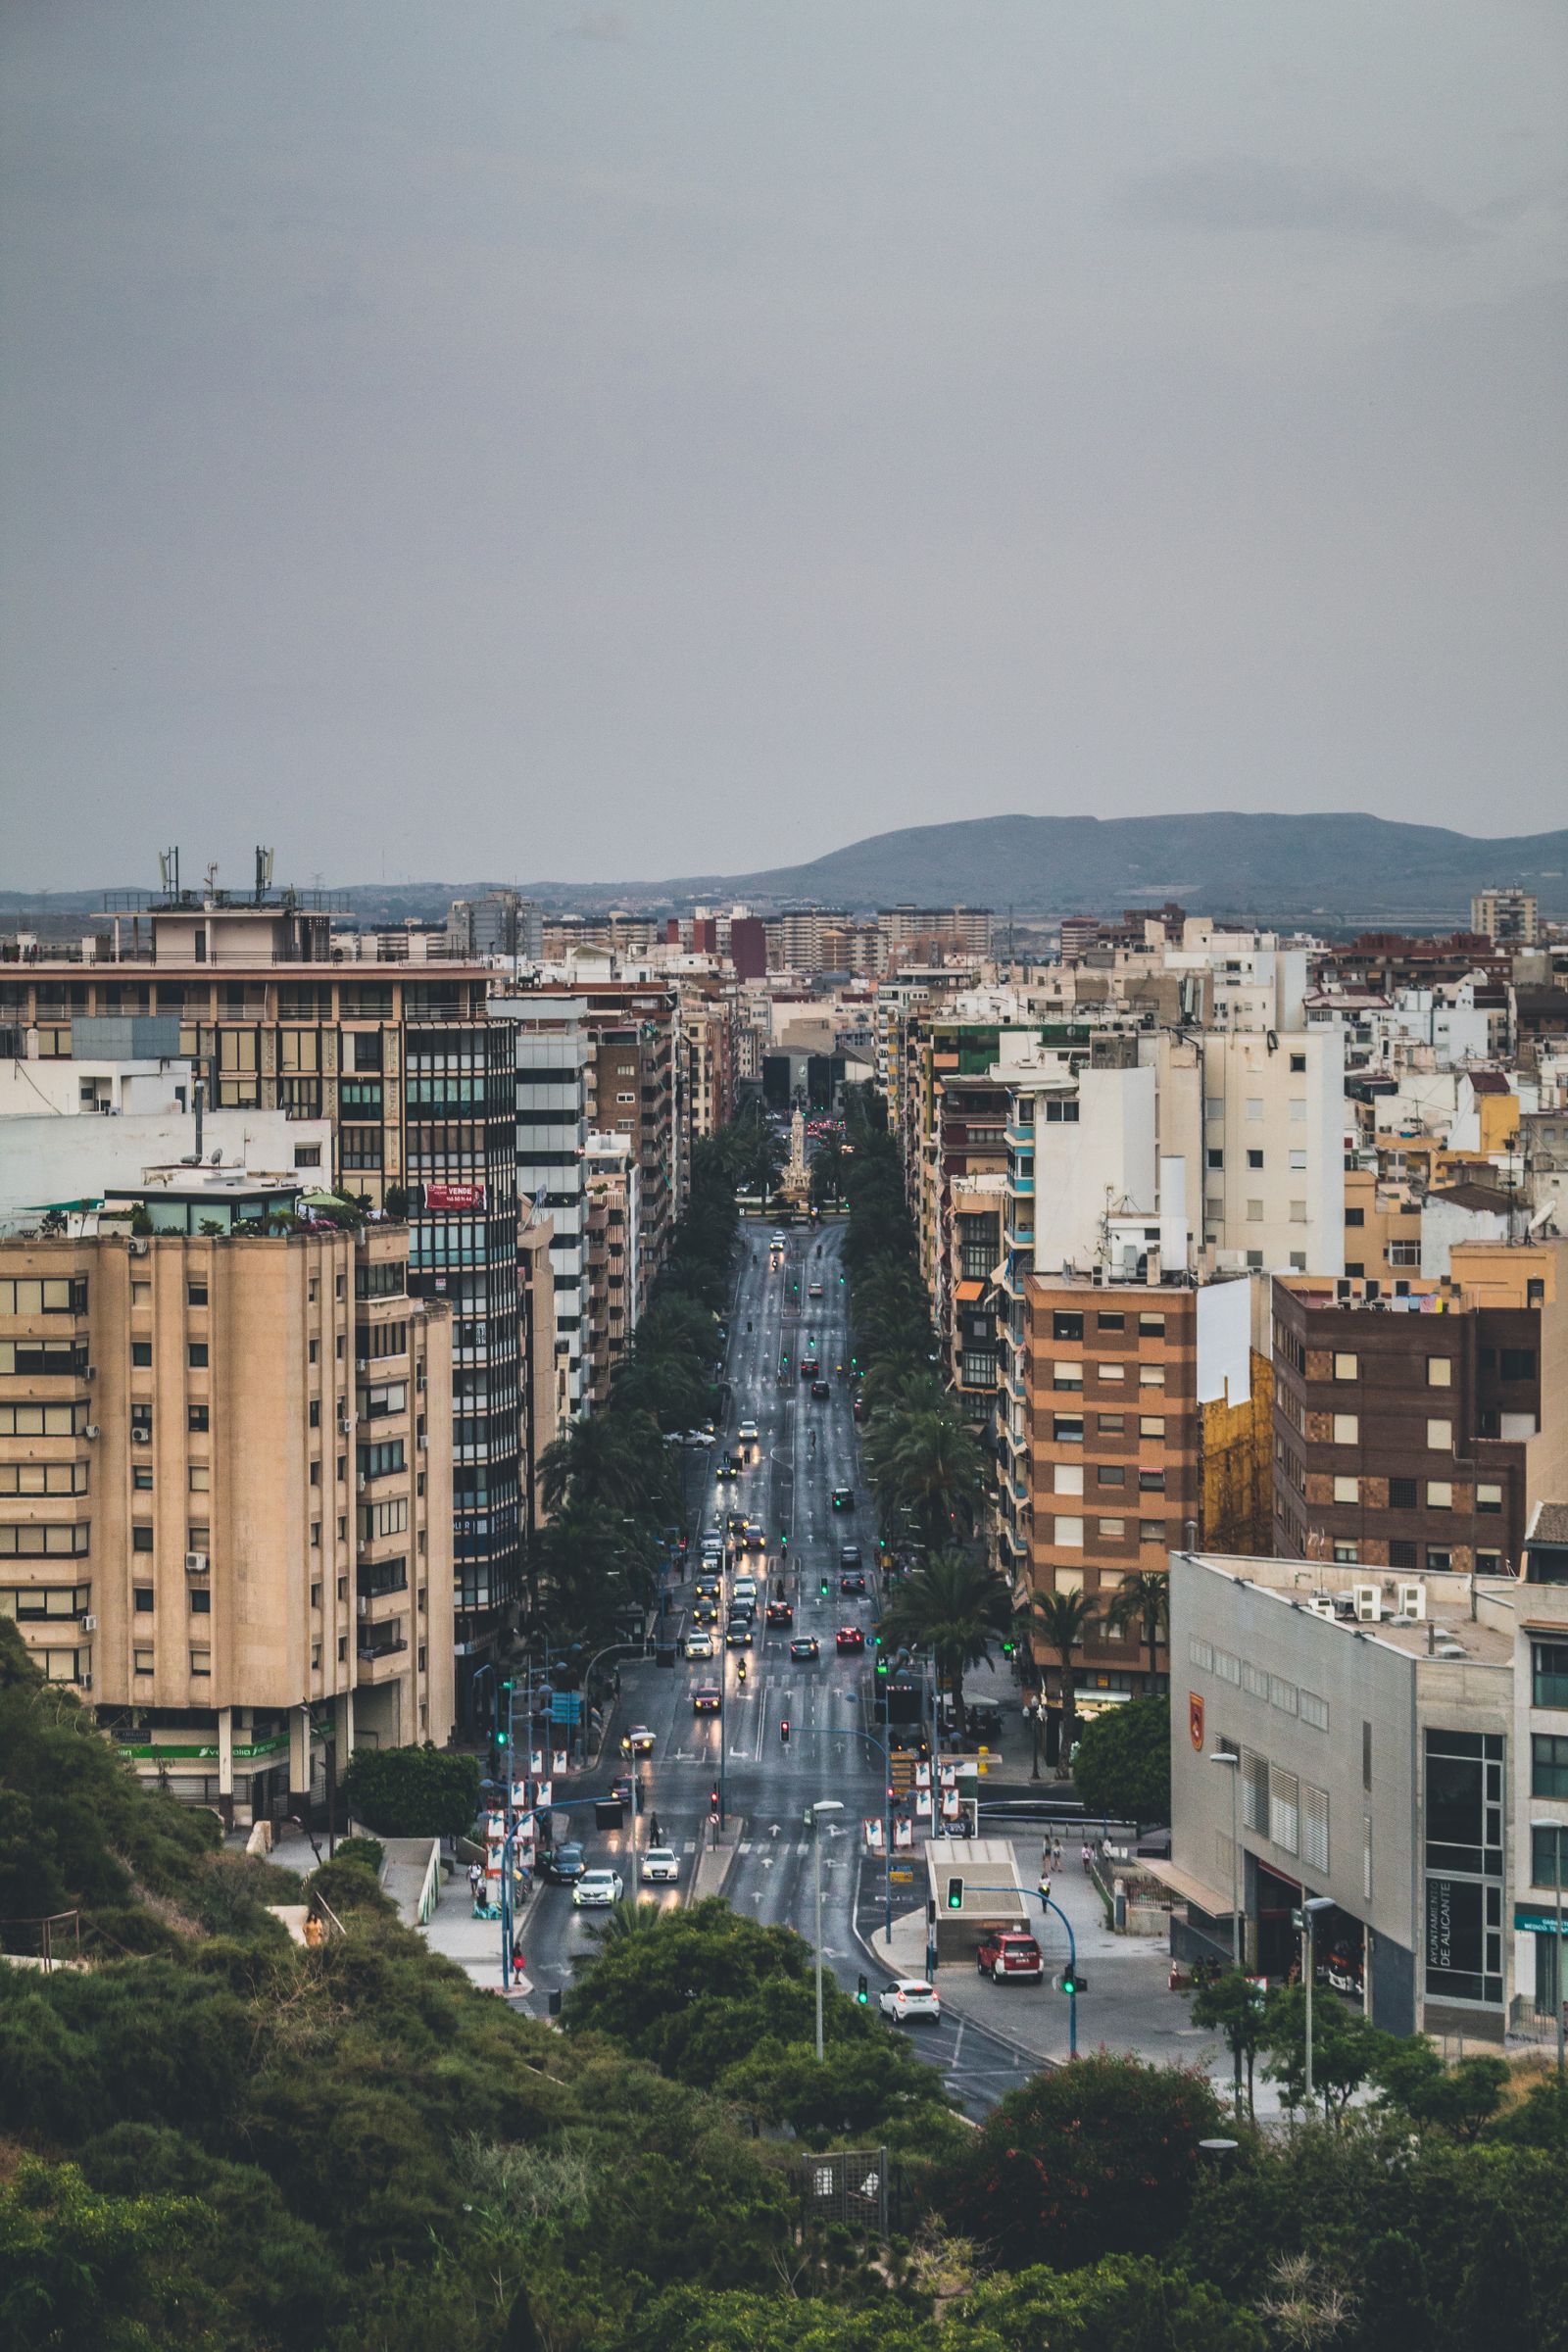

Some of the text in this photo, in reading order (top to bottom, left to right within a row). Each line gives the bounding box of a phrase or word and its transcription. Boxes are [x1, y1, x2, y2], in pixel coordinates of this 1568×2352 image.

[1430, 1881, 1439, 1964] AYUNTAMIENTO
[1441, 1883, 1450, 1967] DE ALICANTE
